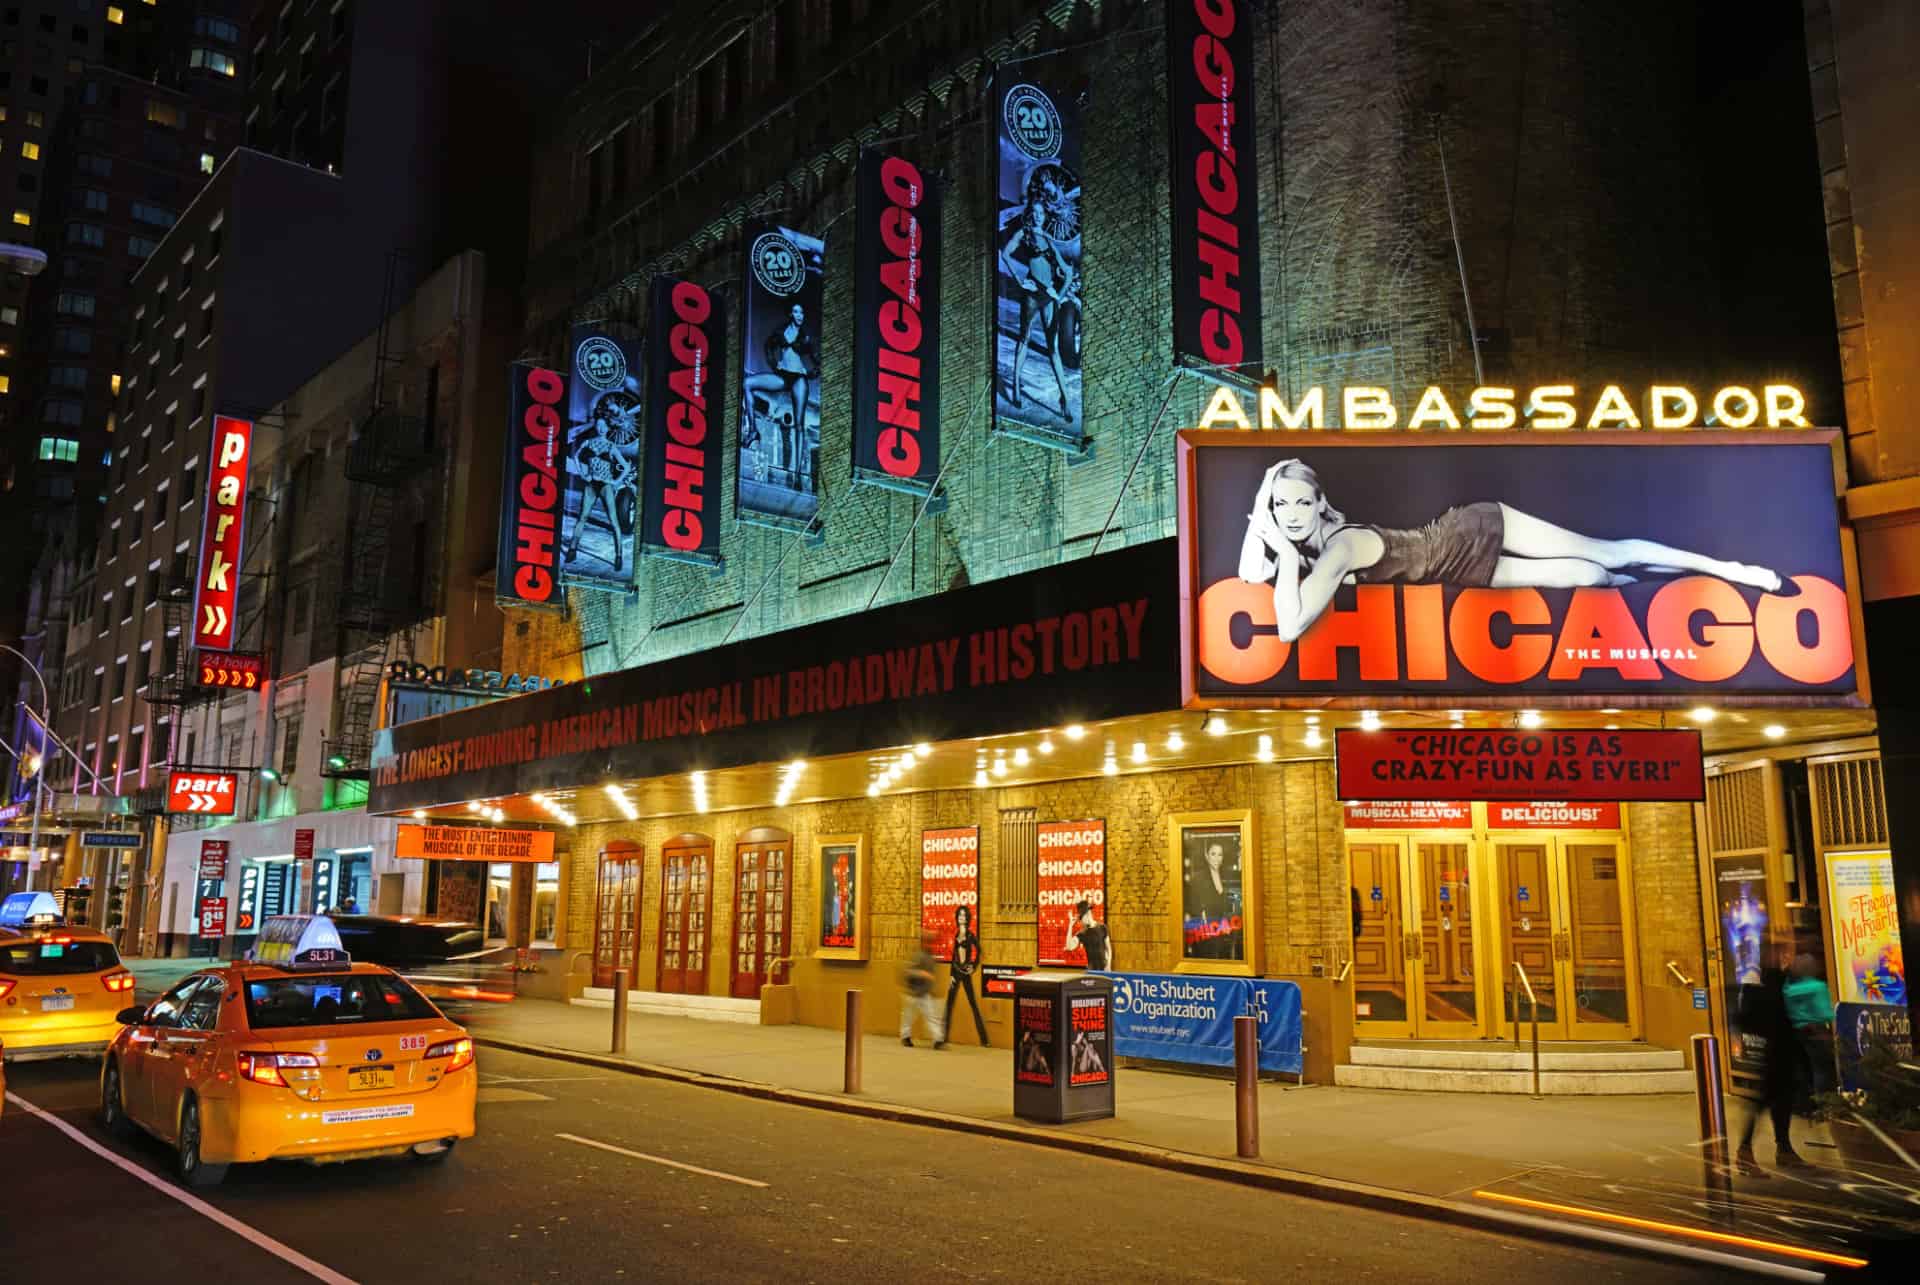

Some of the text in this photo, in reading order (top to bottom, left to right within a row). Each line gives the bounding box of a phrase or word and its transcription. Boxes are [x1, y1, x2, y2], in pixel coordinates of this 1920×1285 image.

[1018, 106, 1048, 129] 20
[764, 251, 792, 270] 20
[877, 157, 923, 478] CHICAGO
[588, 352, 614, 369] 20
[1198, 384, 1812, 430] AMBASSADOR
[662, 281, 711, 551] CHICAGO
[514, 367, 564, 602] CHICAGO
[207, 431, 246, 593] park
[1198, 574, 1853, 685] CHICAGO
[1565, 648, 1697, 660] THE MUSICAL
[376, 598, 1150, 787] THE LONGEST-RUNNING AMERICAN MUSICAL IN BROADWAY HISTORY
[1553, 736, 1577, 756] IS
[1586, 735, 1622, 755] AS
[1371, 760, 1535, 781] CRAZY-FUN
[1545, 761, 1581, 781] AS
[174, 776, 232, 794] park
[1351, 808, 1408, 818] MUSICAL
[423, 827, 439, 840] THE
[470, 830, 533, 844] ENTERTAINING
[923, 836, 977, 852] CHICAGO
[1038, 830, 1104, 848] CHICAGO
[423, 842, 532, 857] MUSICAL OF THE DECADE
[923, 863, 977, 879] CHICAGO
[1038, 860, 1104, 877] CHICAGO
[923, 890, 977, 906] CHICAGO
[1038, 889, 1104, 905] CHICAGO
[310, 950, 335, 961] 5L31
[1132, 978, 1216, 1002] The Shubert
[1072, 1007, 1105, 1020] SURE
[1132, 997, 1216, 1020] Organization
[1072, 1020, 1105, 1032] THING
[401, 1037, 425, 1050] 389
[1071, 1071, 1109, 1083] CHICAGO
